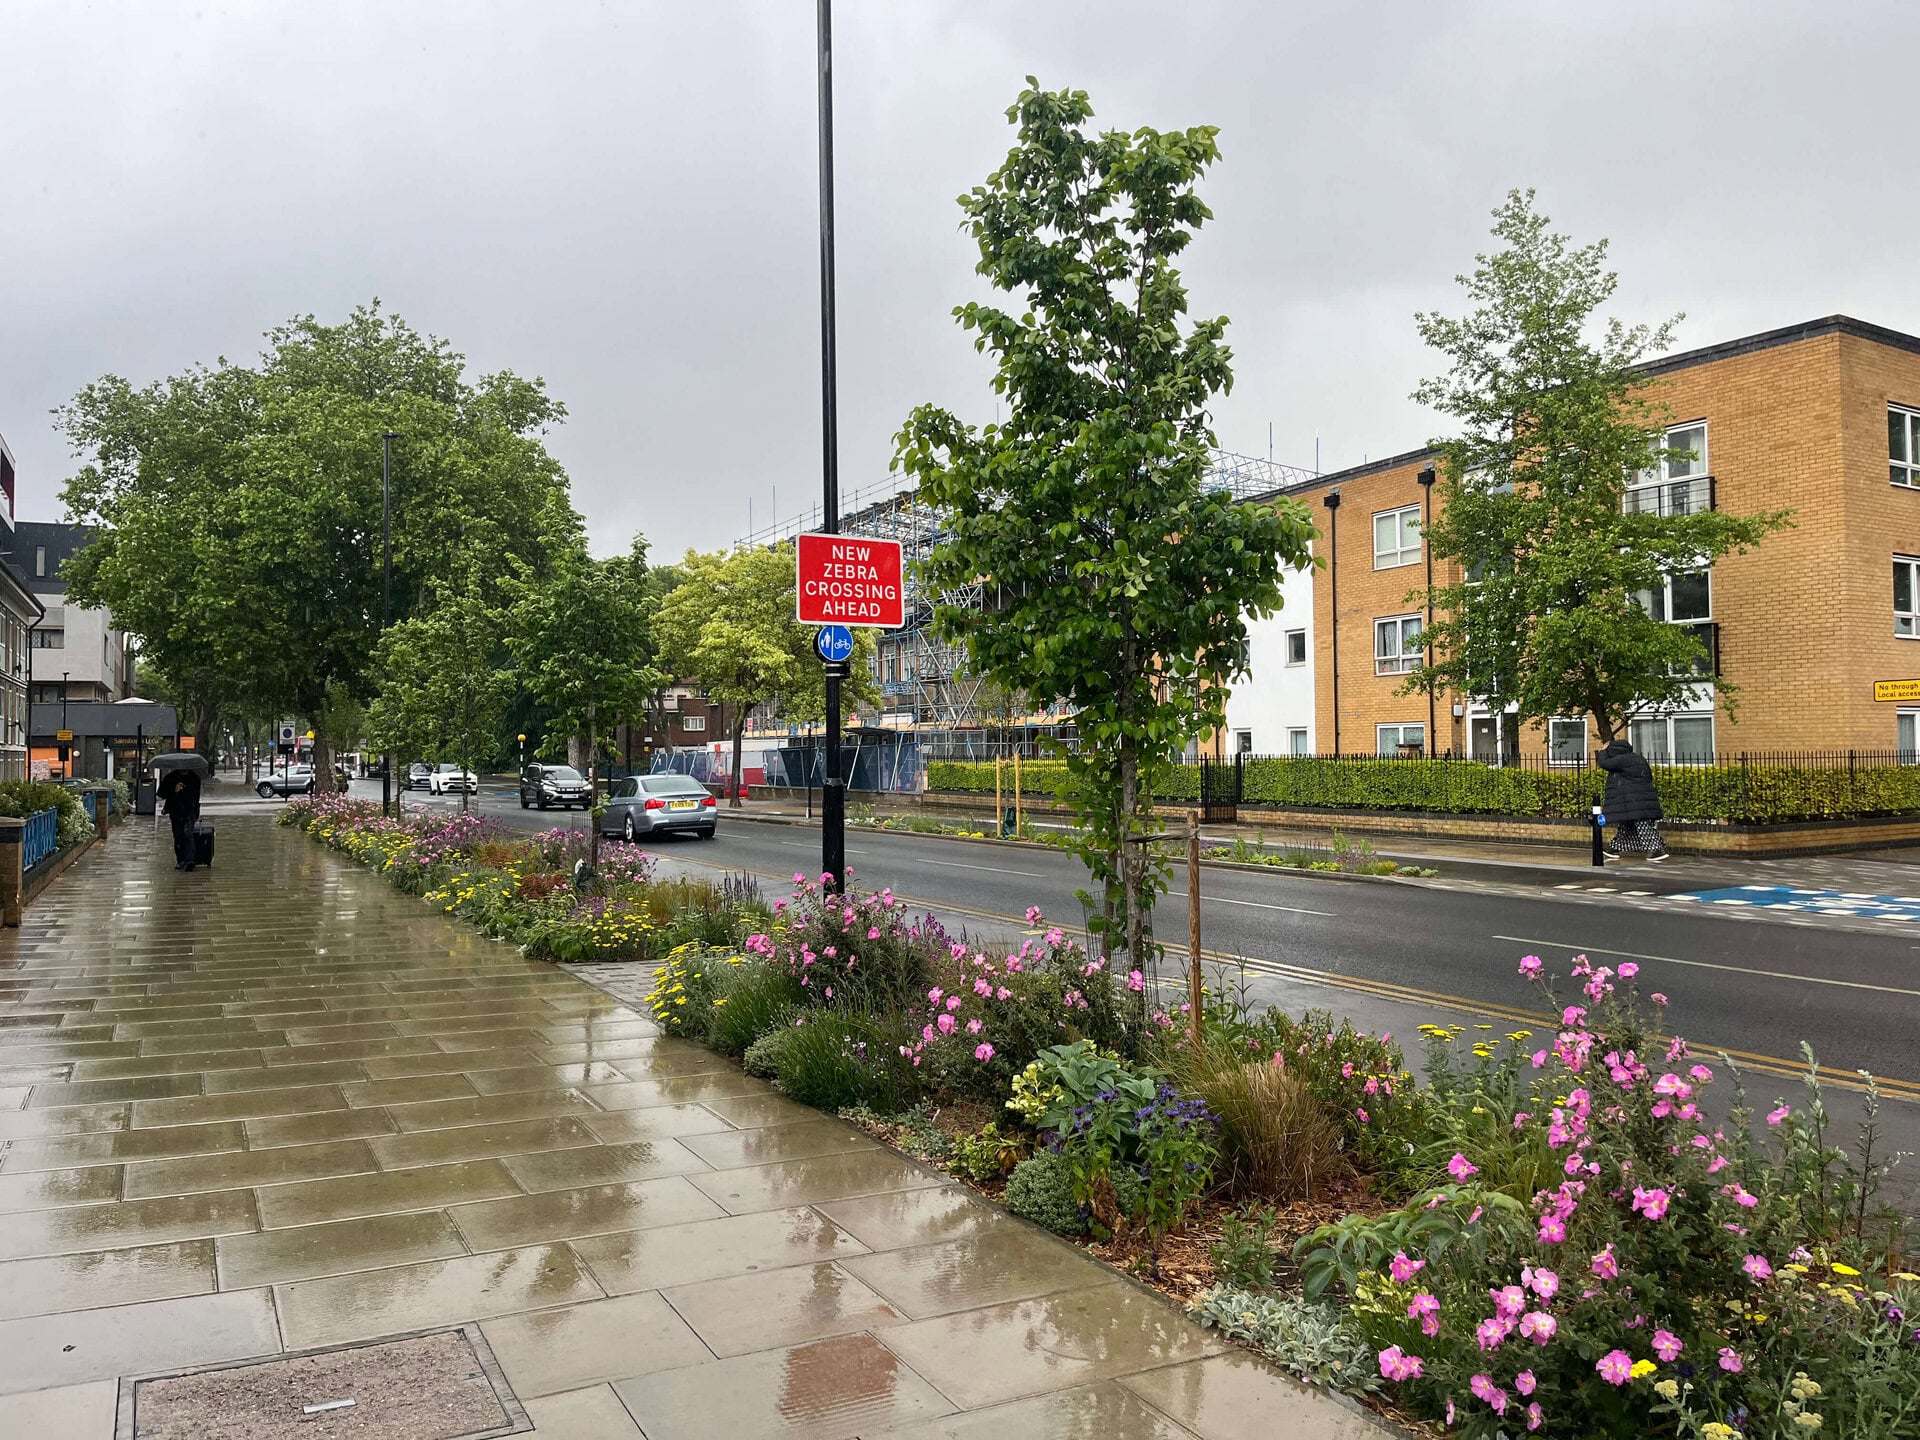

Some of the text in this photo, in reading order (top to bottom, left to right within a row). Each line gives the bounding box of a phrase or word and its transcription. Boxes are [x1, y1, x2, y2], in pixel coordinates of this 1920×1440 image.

[832, 545, 870, 561] NEW
[823, 563, 878, 581] ZEBRA
[805, 581, 896, 600] CROSSING
[822, 601, 881, 617] AHEAD
[1891, 683, 1919, 691] through
